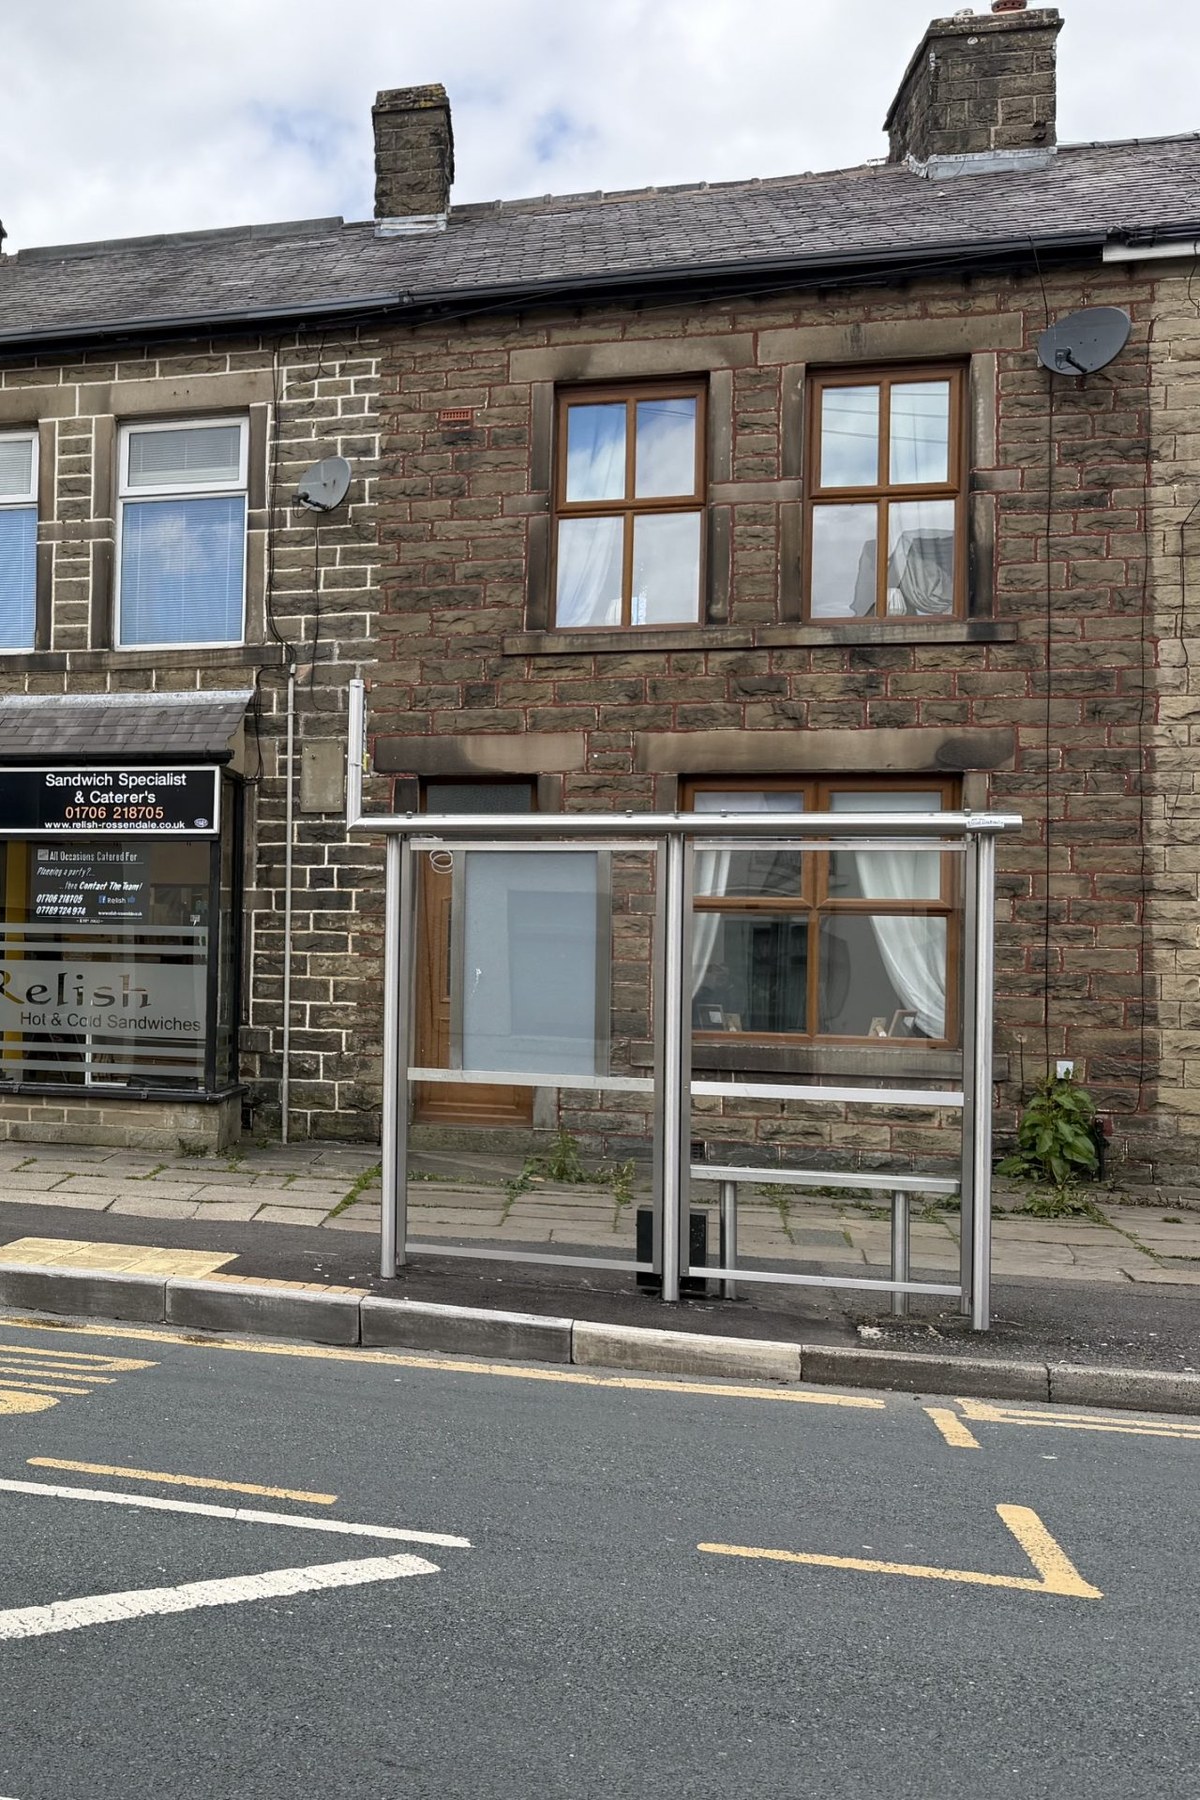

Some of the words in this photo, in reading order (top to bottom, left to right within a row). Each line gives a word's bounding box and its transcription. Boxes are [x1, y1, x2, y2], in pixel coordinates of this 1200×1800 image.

[45, 773, 113, 787] Sandwich
[118, 772, 187, 789] Specialist
[74, 790, 85, 804] &
[89, 790, 156, 804] Caterer's
[65, 806, 107, 819] 01706
[113, 806, 164, 819] 218705
[44, 820, 185, 829] www.relish-rossendale.co.uk
[49, 850, 59, 861] All
[60, 850, 95, 861] Occasions
[96, 851, 125, 862] Catered
[125, 851, 138, 862] For
[78, 881, 108, 891] Contact
[108, 881, 121, 891] The
[122, 881, 143, 892] Team!
[36, 893, 58, 904] 01706
[20, 1011, 46, 1026] Hot
[50, 1012, 62, 1027] &
[66, 1012, 102, 1028] Cold
[107, 1014, 201, 1032] Sandwiches
